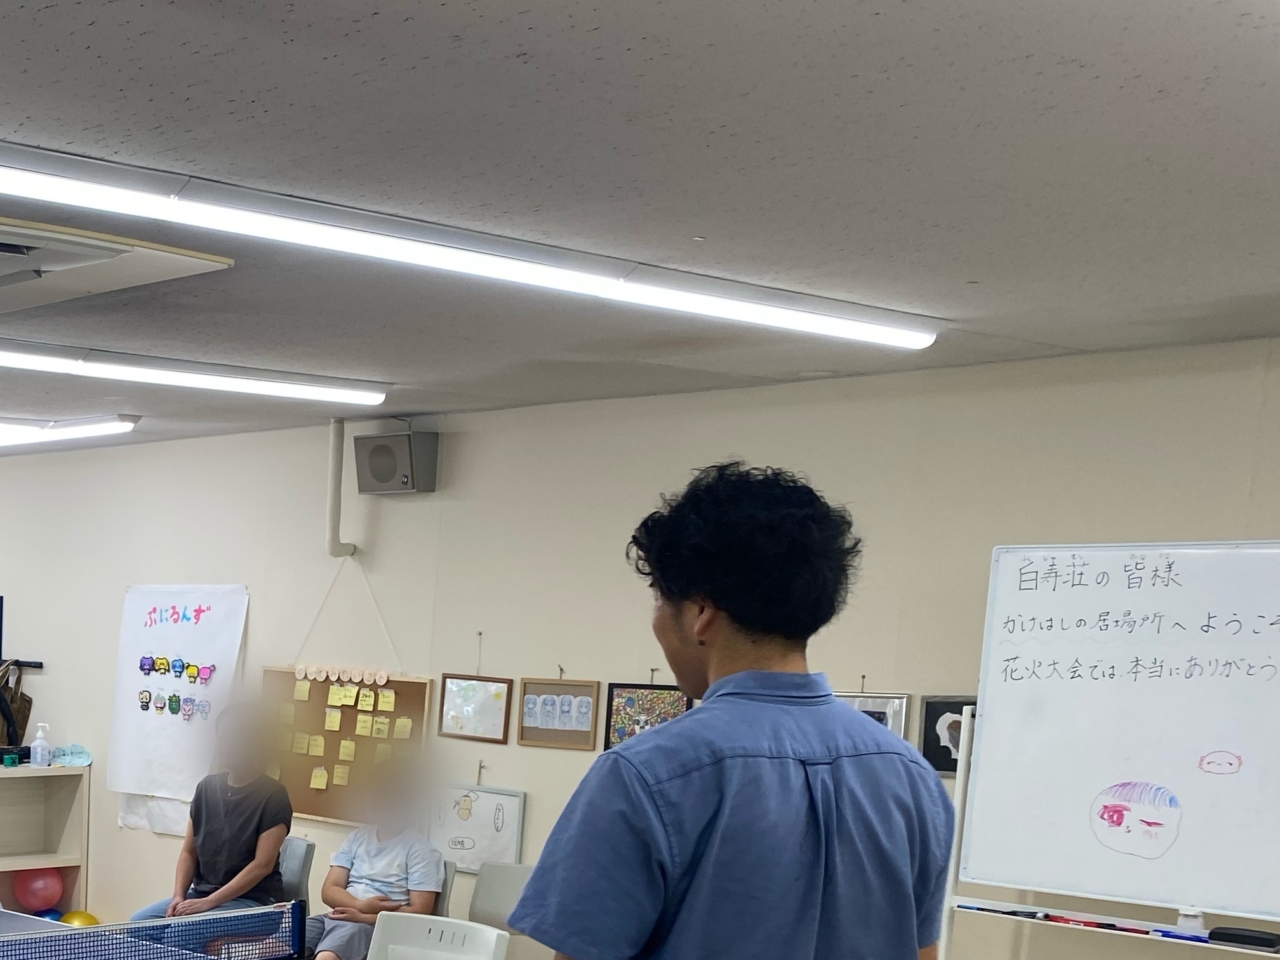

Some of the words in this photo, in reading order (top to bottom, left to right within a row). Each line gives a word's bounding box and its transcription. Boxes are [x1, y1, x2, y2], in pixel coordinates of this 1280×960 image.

[143, 604, 212, 628] ぷにるんず
